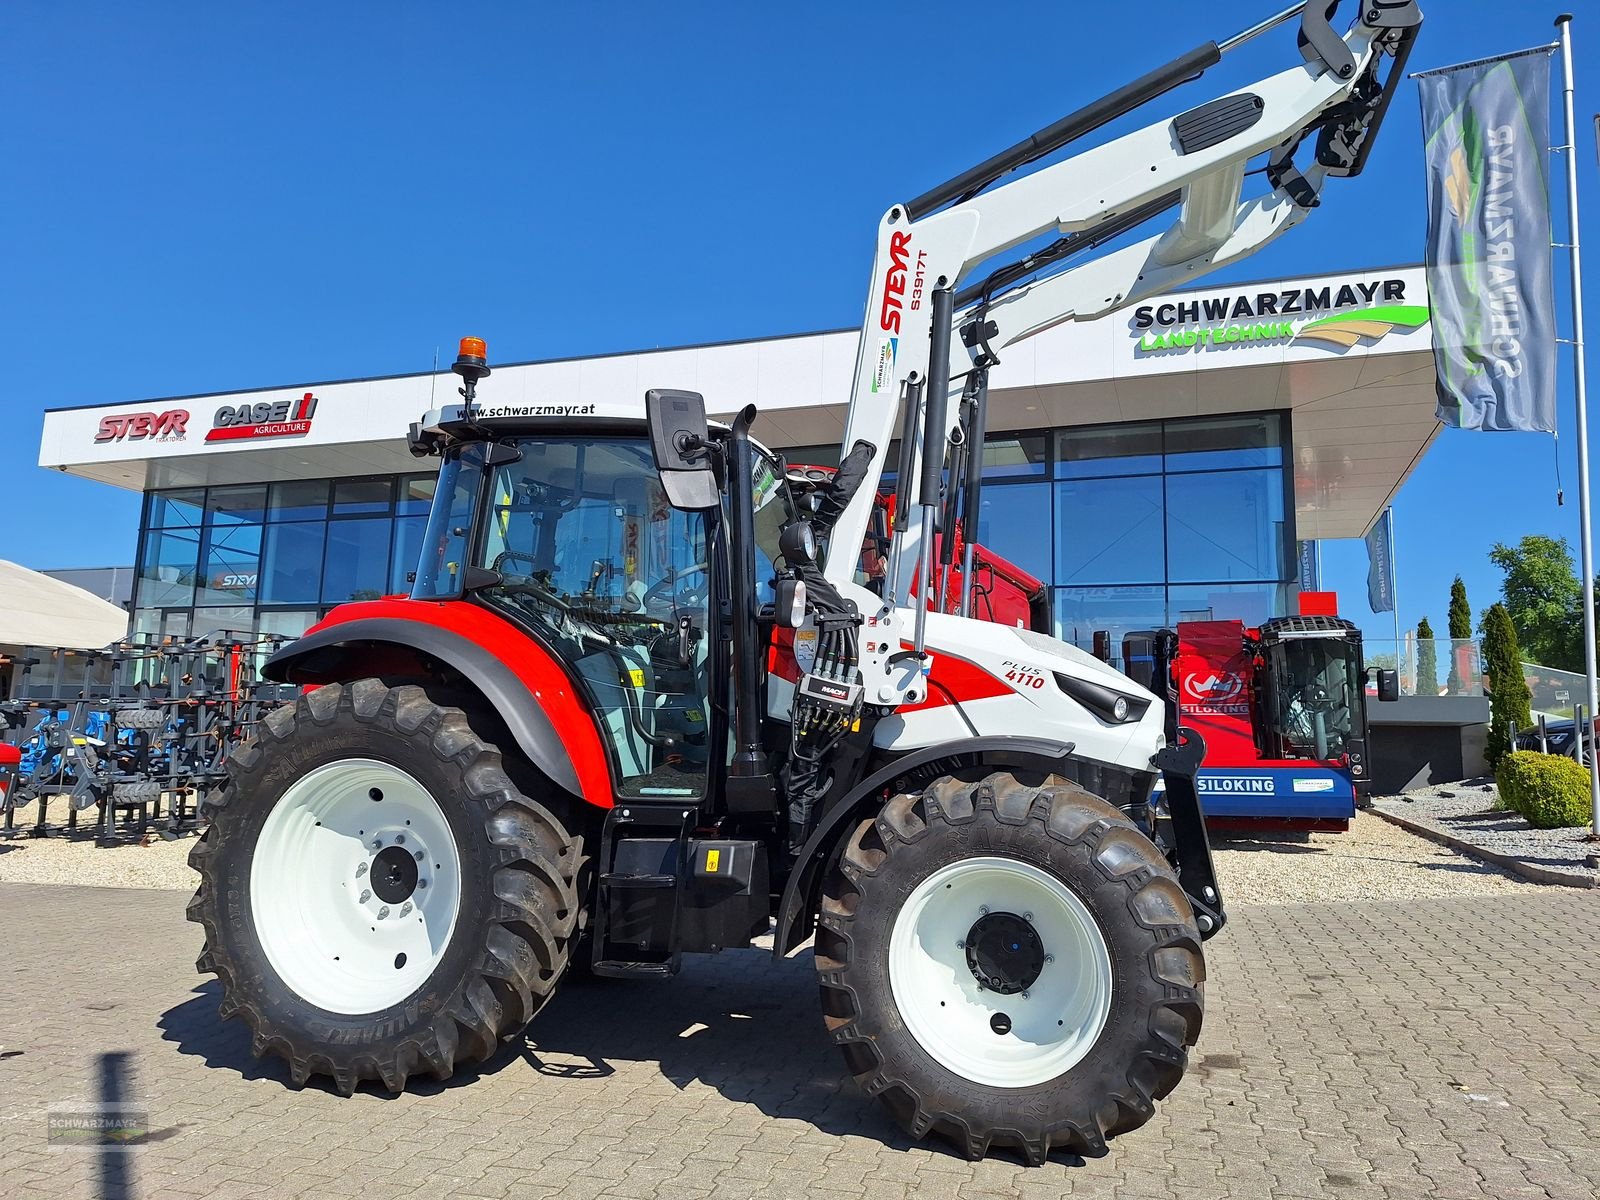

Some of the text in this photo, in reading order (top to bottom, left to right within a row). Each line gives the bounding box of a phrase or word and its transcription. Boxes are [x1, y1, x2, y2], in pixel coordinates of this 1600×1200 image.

[880, 231, 912, 335] STEYR
[911, 250, 928, 311] S3917T
[1134, 279, 1406, 329] SCHWARZMAYR
[1140, 321, 1294, 351] LANDTECHNIK
[213, 401, 291, 428] CASE
[456, 403, 596, 419] ww.schwarzmayr.at
[95, 409, 190, 440] STEYR
[253, 423, 306, 435] AGRICULTURE
[155, 435, 187, 443] TRAKTOREN
[1002, 661, 1042, 675] PLUS
[1005, 670, 1045, 689] 4110
[821, 686, 846, 696] MACH
[1181, 705, 1249, 713] SILOKING
[1197, 780, 1274, 791] SILOKING
